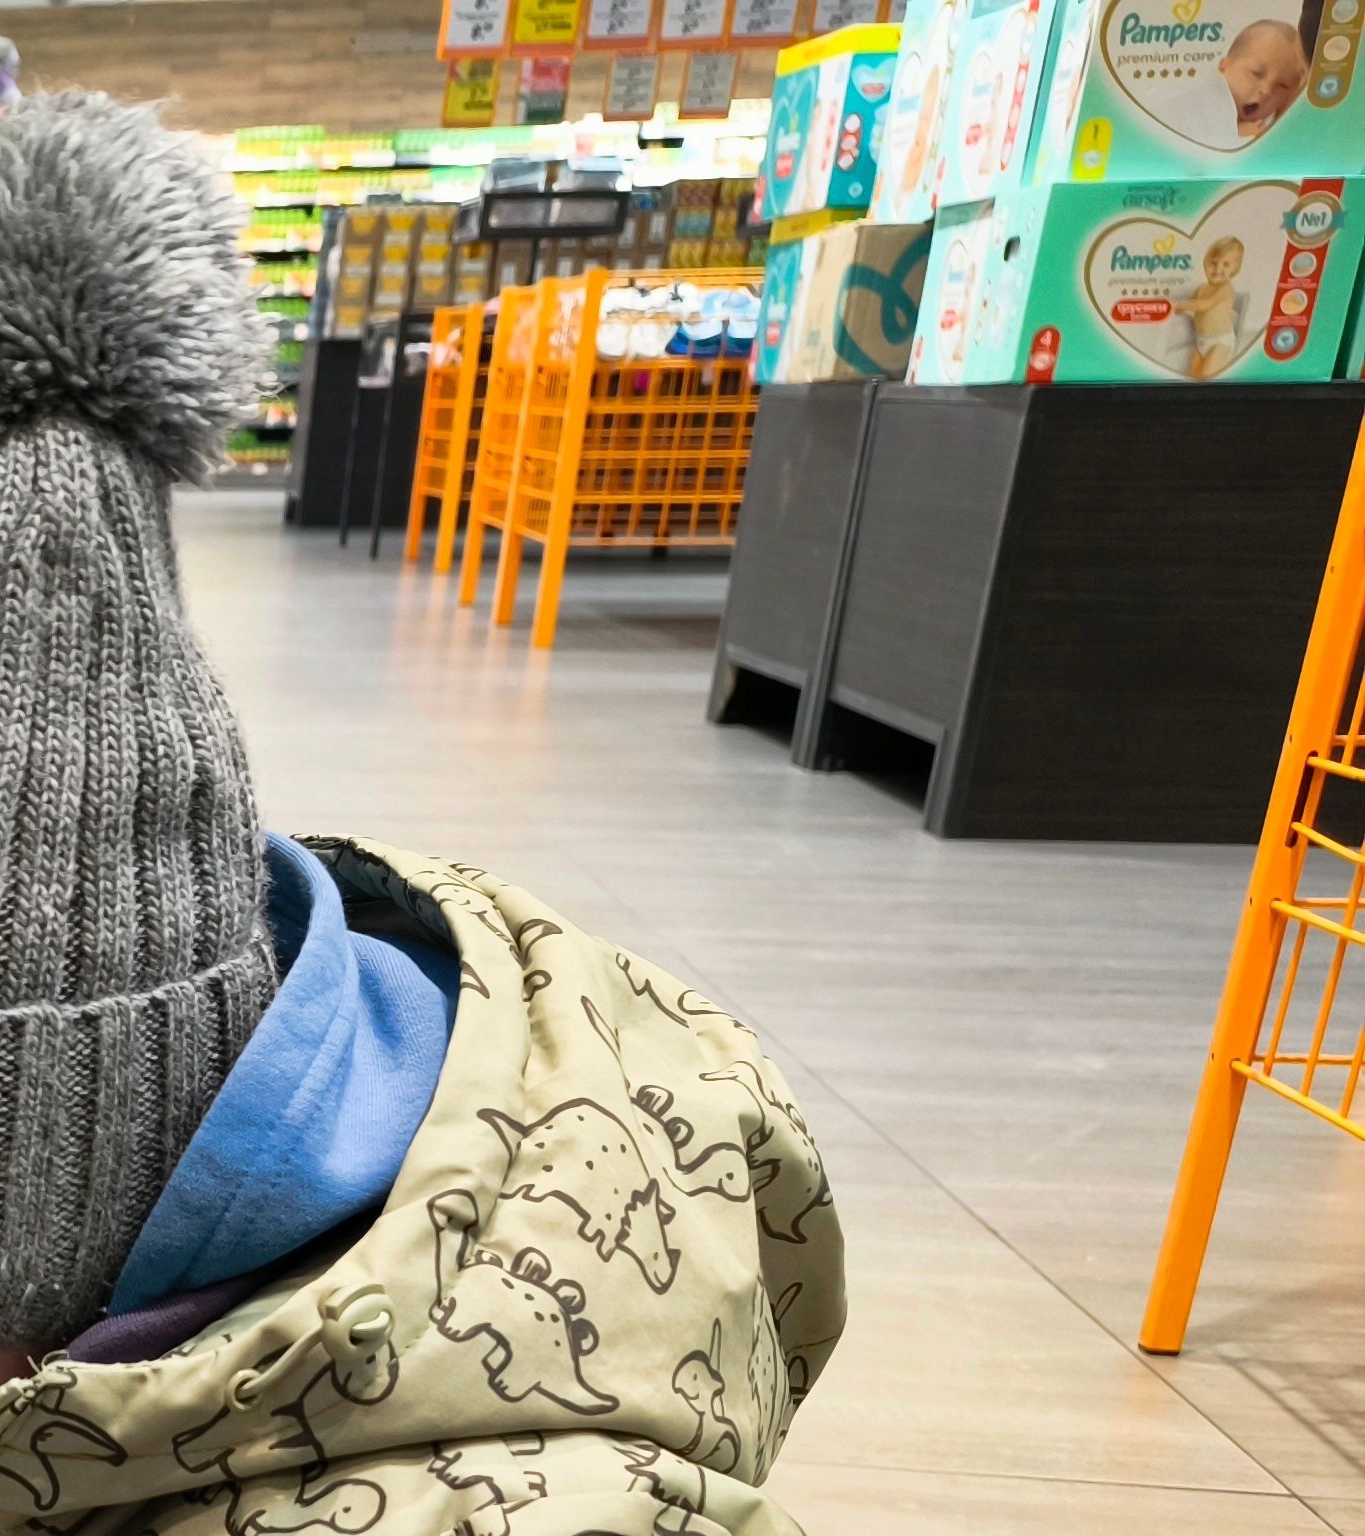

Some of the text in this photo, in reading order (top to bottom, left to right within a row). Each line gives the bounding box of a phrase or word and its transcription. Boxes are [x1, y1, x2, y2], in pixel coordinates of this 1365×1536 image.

[1119, 12, 1222, 49] Pampers
[1117, 50, 1216, 68] premium care
[1110, 244, 1193, 276] Pampers
